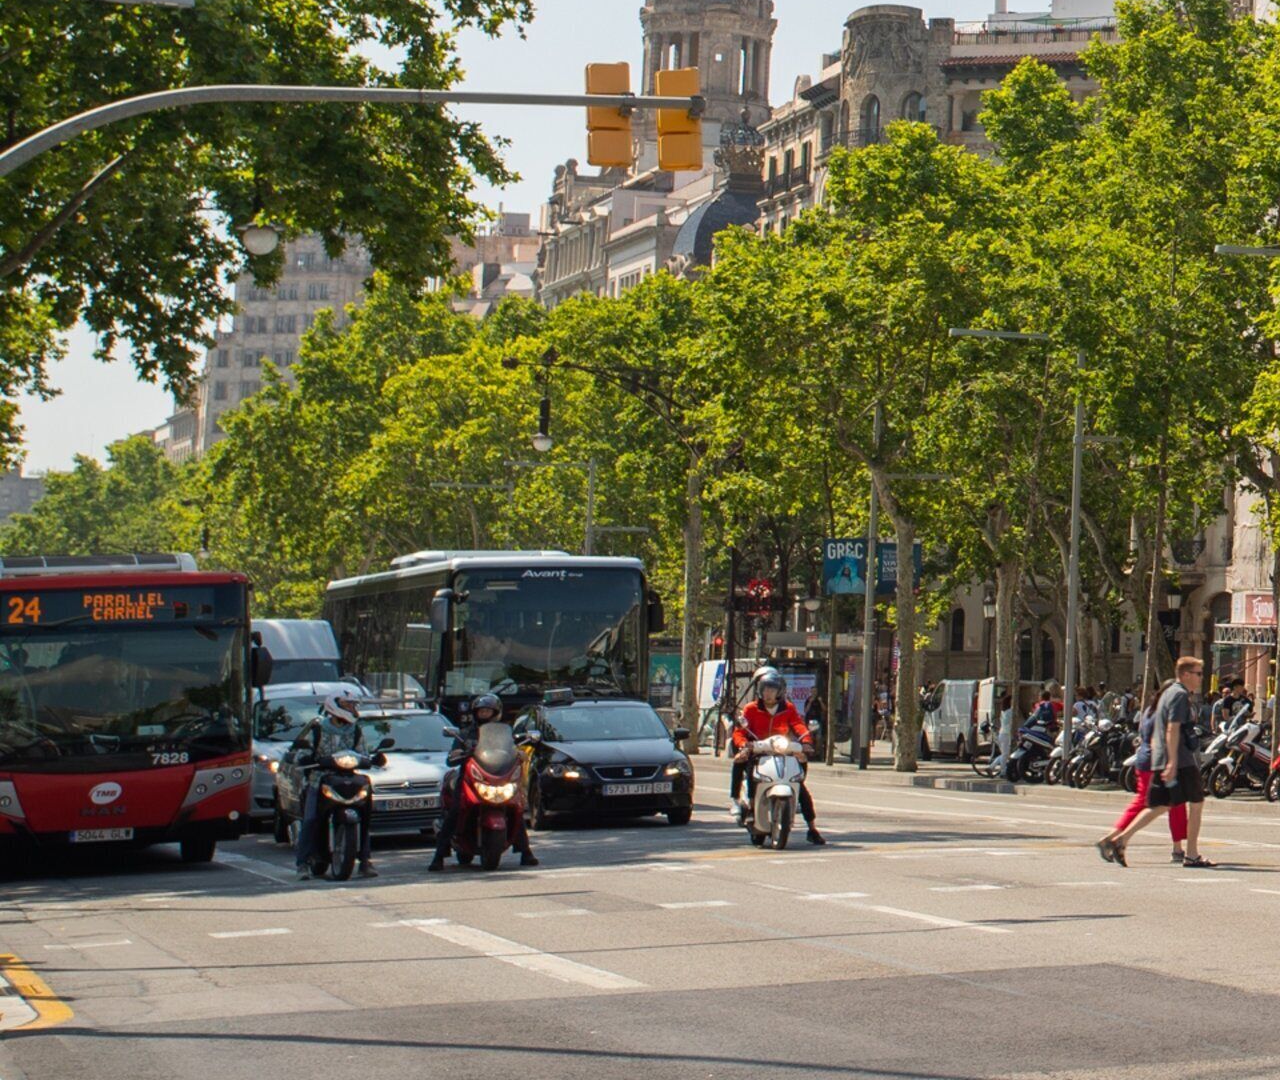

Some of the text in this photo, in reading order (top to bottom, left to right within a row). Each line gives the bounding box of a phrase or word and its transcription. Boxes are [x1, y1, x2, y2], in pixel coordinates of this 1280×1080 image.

[827, 542, 863, 559] GREC
[521, 569, 567, 580] Avant
[8, 596, 41, 624] 24
[92, 606, 153, 620] CARMEL
[152, 752, 189, 765] 7828
[95, 789, 118, 798] TMB
[78, 830, 105, 841] 5044
